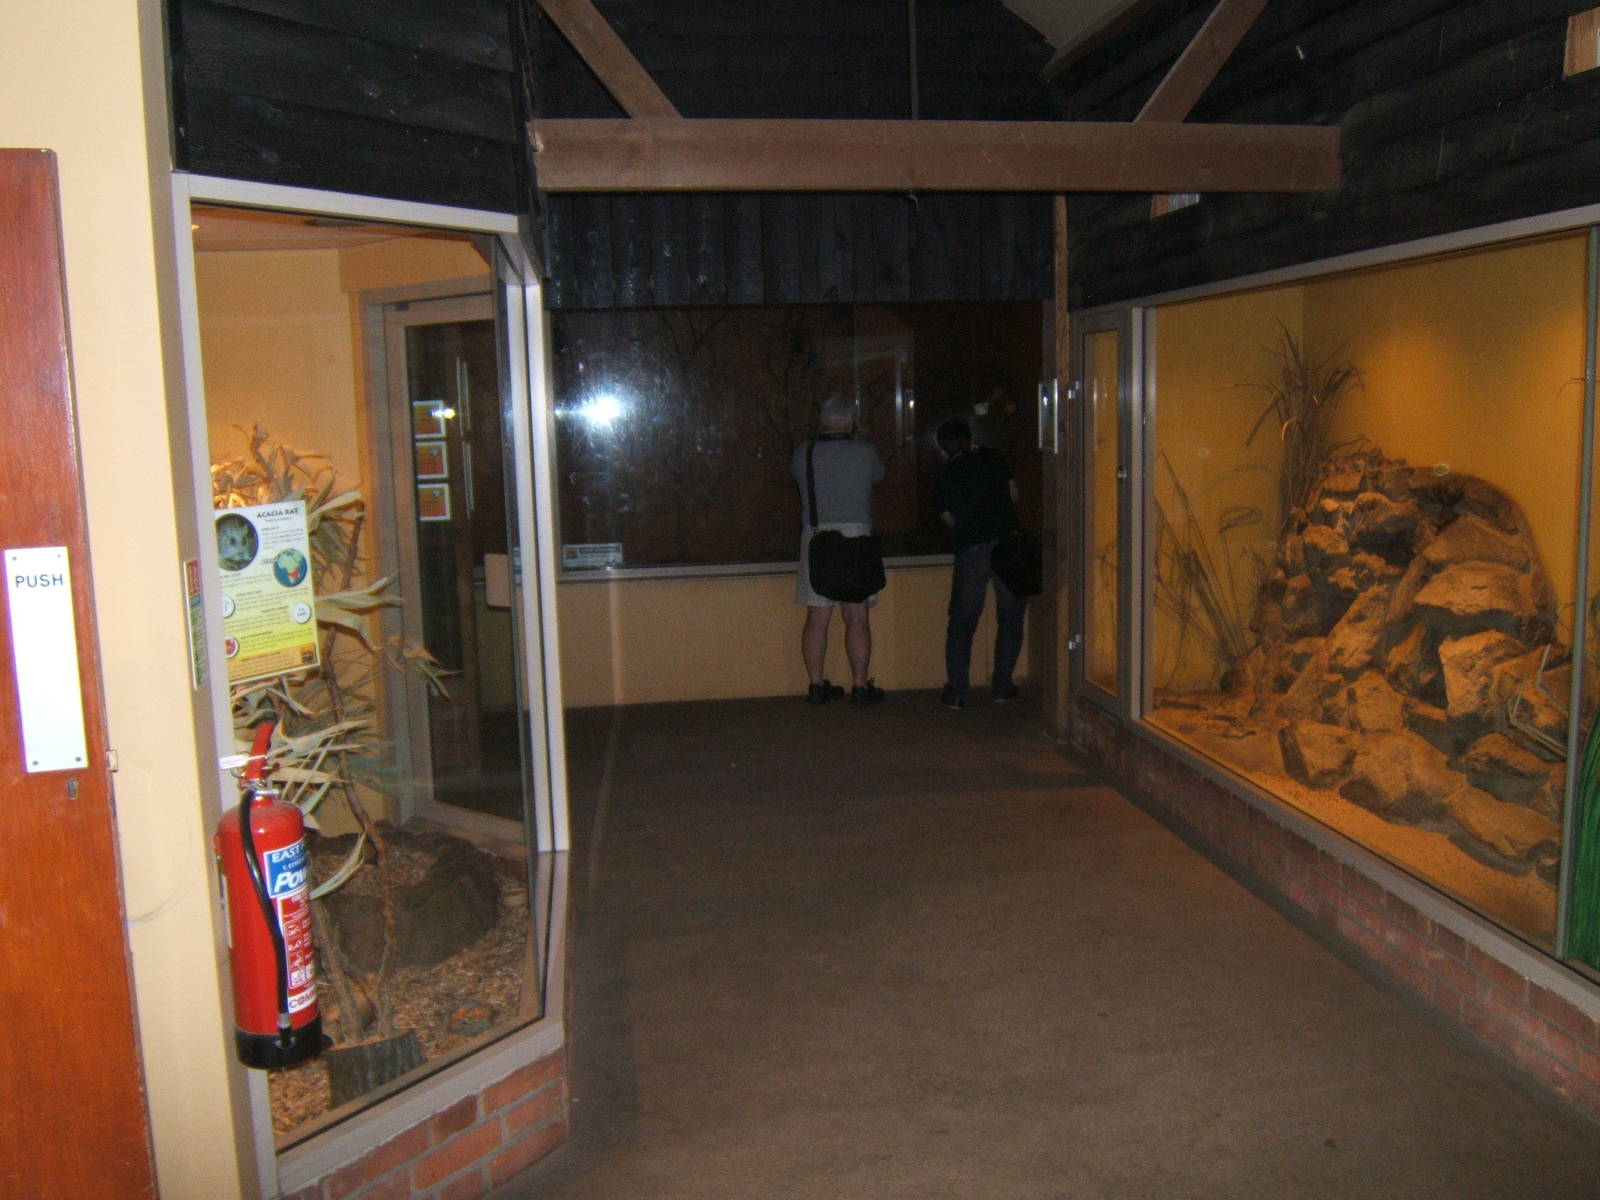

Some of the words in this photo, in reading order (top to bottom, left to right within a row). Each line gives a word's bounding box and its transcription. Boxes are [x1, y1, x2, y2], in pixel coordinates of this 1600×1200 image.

[256, 509, 283, 518] ACACIA
[285, 507, 299, 515] RAT
[15, 573, 63, 589] PUSH
[271, 844, 300, 863] EAST
